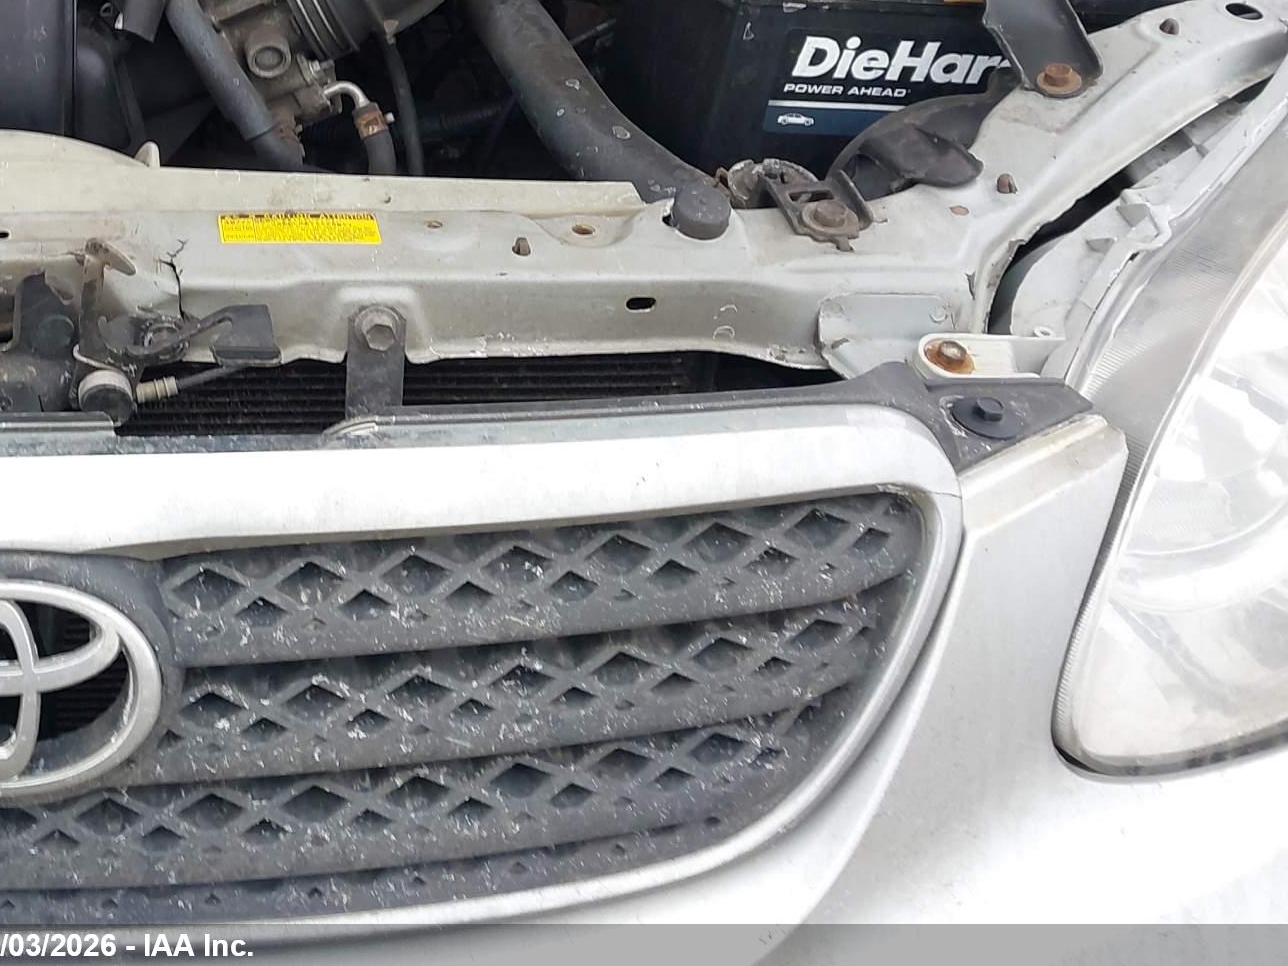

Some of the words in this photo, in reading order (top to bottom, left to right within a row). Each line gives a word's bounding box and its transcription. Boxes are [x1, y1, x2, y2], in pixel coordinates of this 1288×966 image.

[791, 35, 1012, 85] DieHar
[783, 83, 844, 96] POWER
[847, 86, 908, 99] AHEAD
